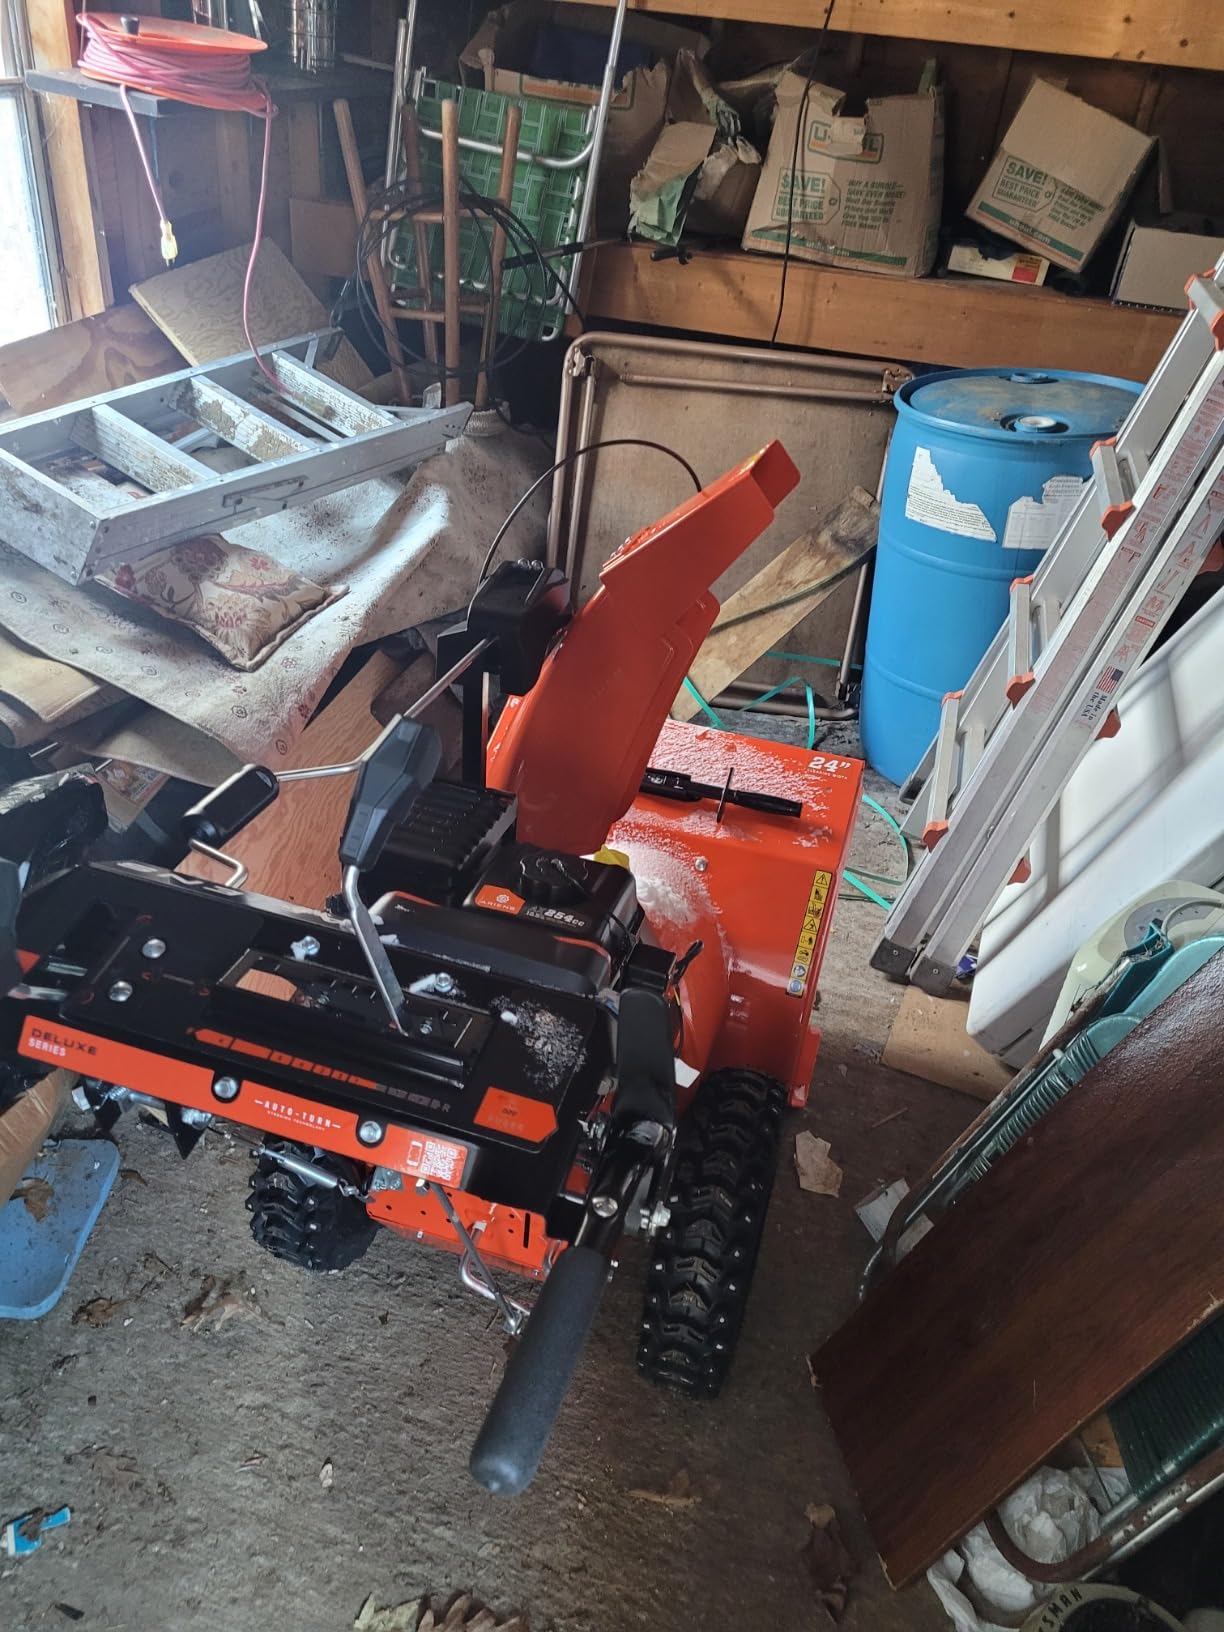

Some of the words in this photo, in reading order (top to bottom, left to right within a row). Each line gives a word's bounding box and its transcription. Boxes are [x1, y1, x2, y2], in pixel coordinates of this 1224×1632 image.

[1006, 161, 1048, 186] SAVE!
[479, 898, 517, 912] ARIENS
[28, 1037, 67, 1057] SERIES
[31, 1028, 98, 1056] DELUXE
